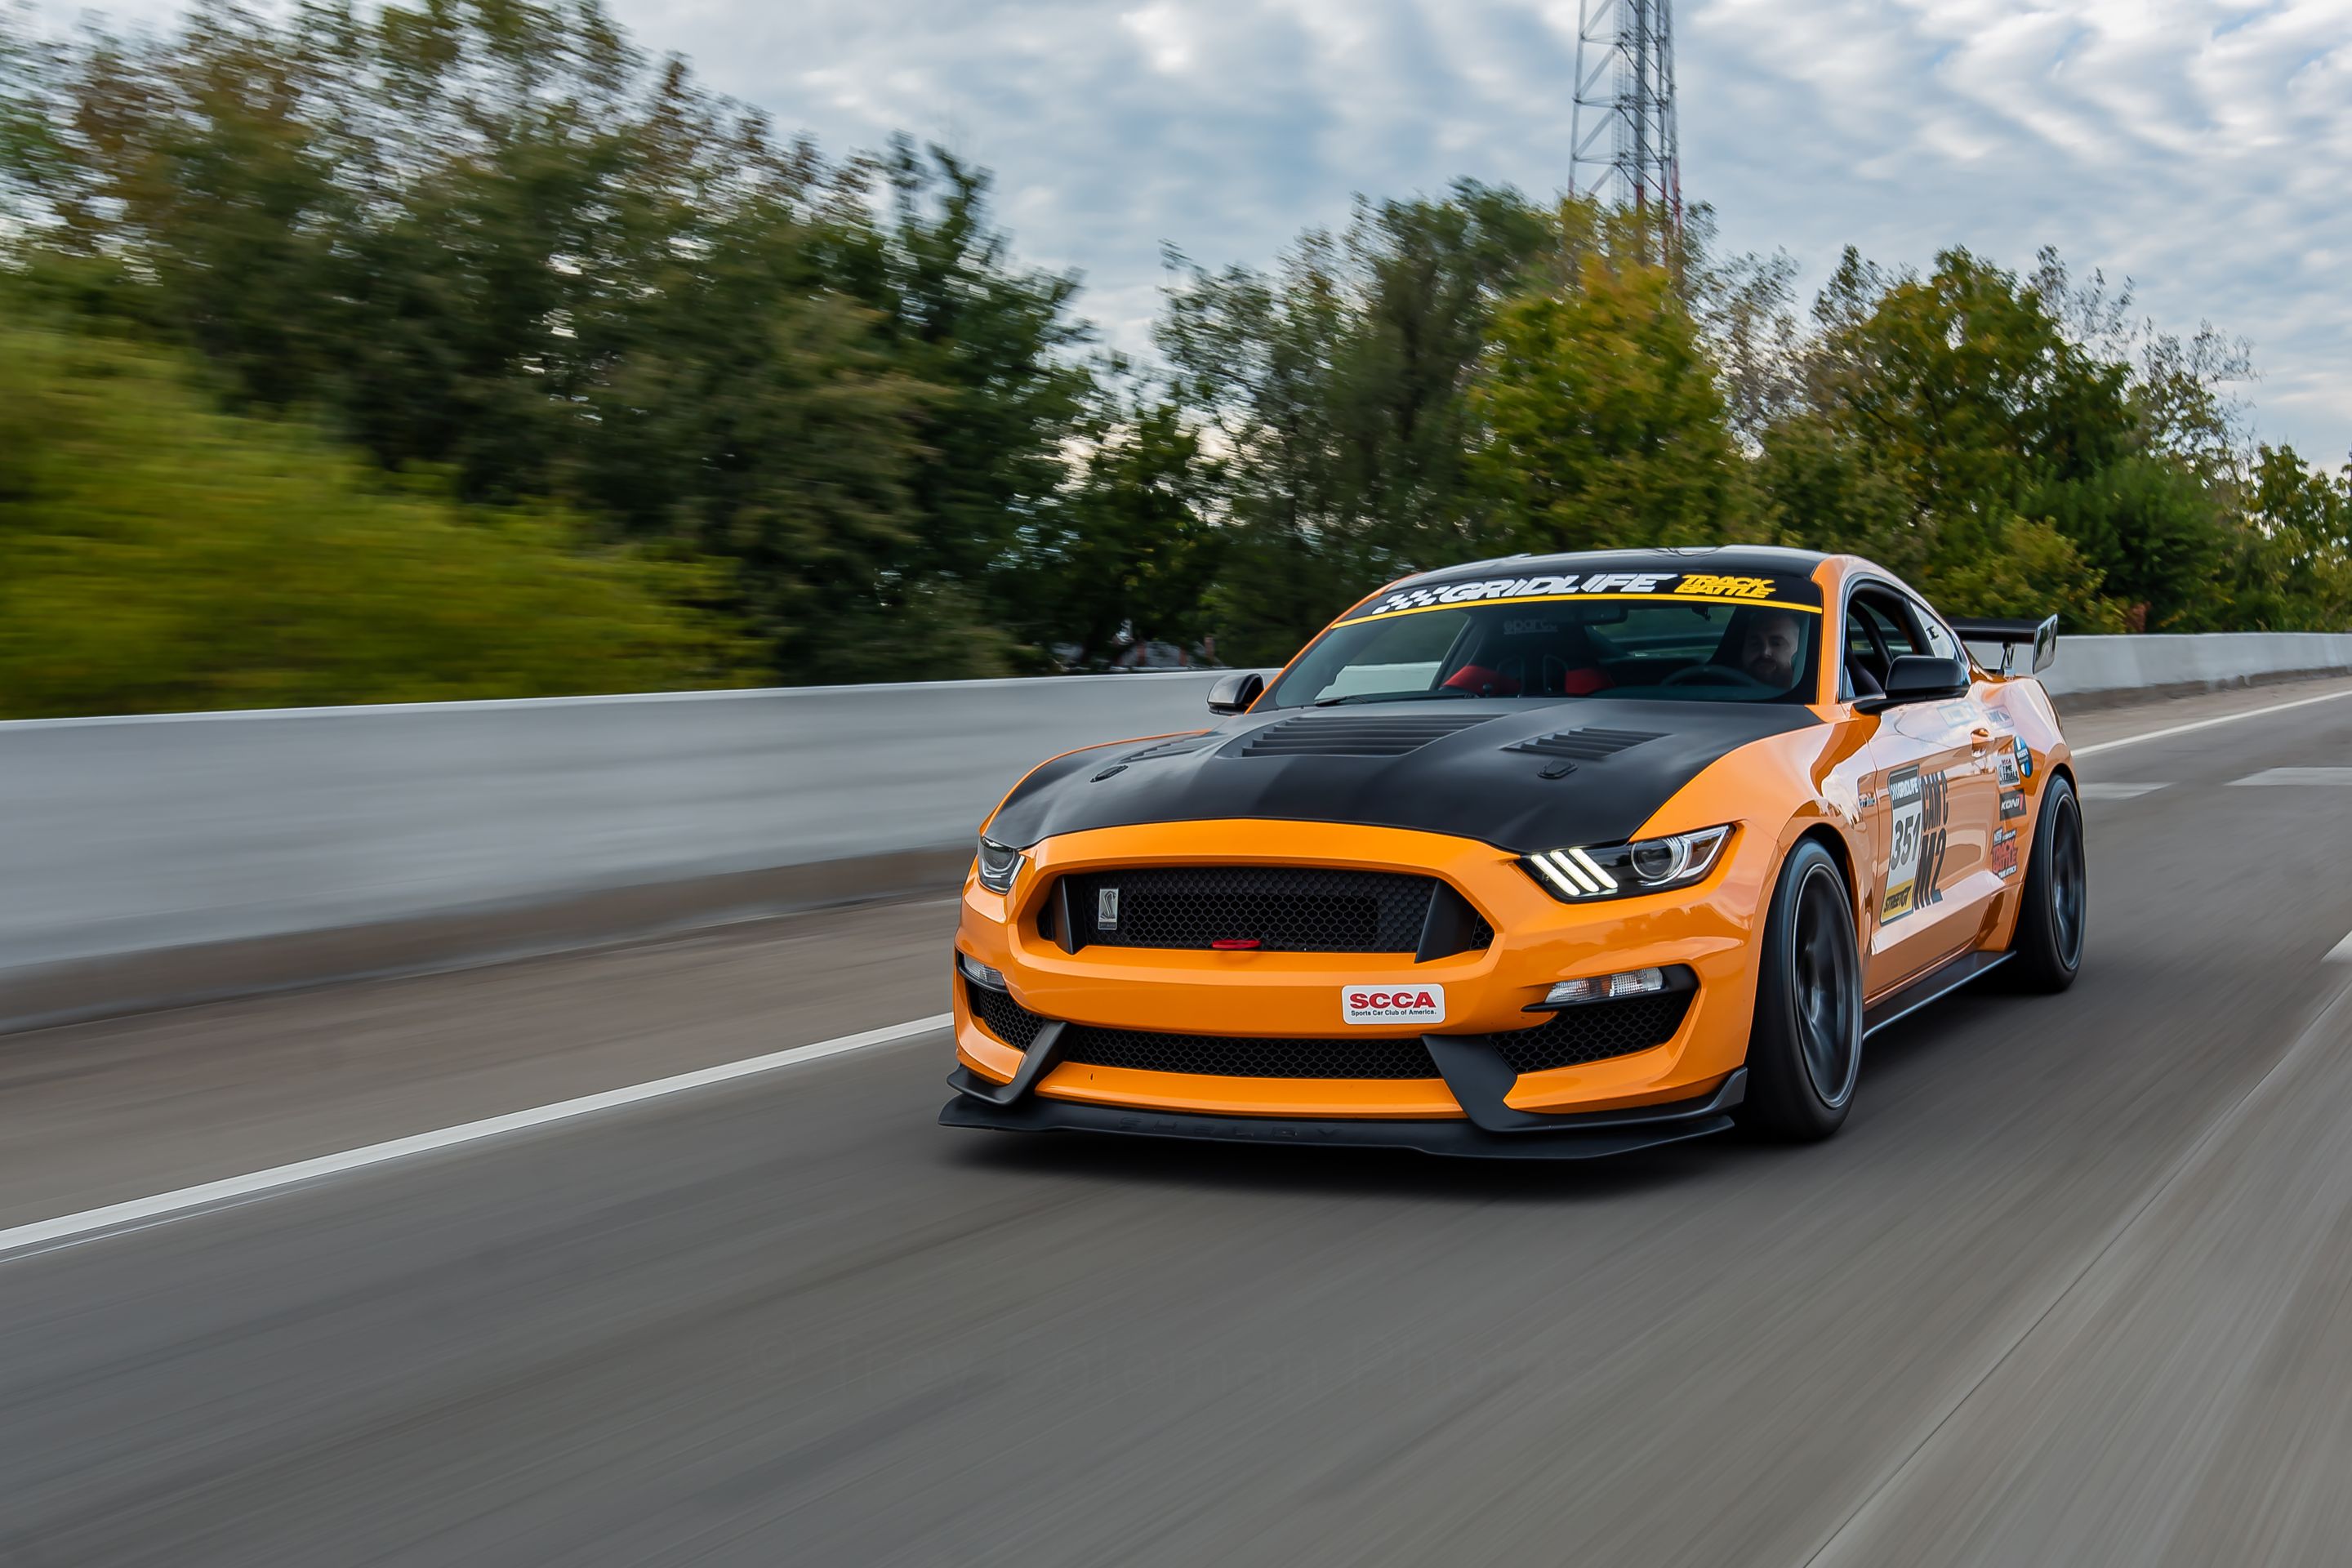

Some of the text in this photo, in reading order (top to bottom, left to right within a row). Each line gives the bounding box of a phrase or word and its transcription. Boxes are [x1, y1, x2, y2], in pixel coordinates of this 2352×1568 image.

[1439, 573, 1677, 603] GRIDLIFE
[1682, 574, 1775, 589] TRACK
[1674, 584, 1776, 598] BATTLE
[2001, 797, 2020, 811] KONI
[1891, 813, 1921, 871] 351
[1913, 828, 1947, 911] M2
[1349, 991, 1437, 1009] SCCA
